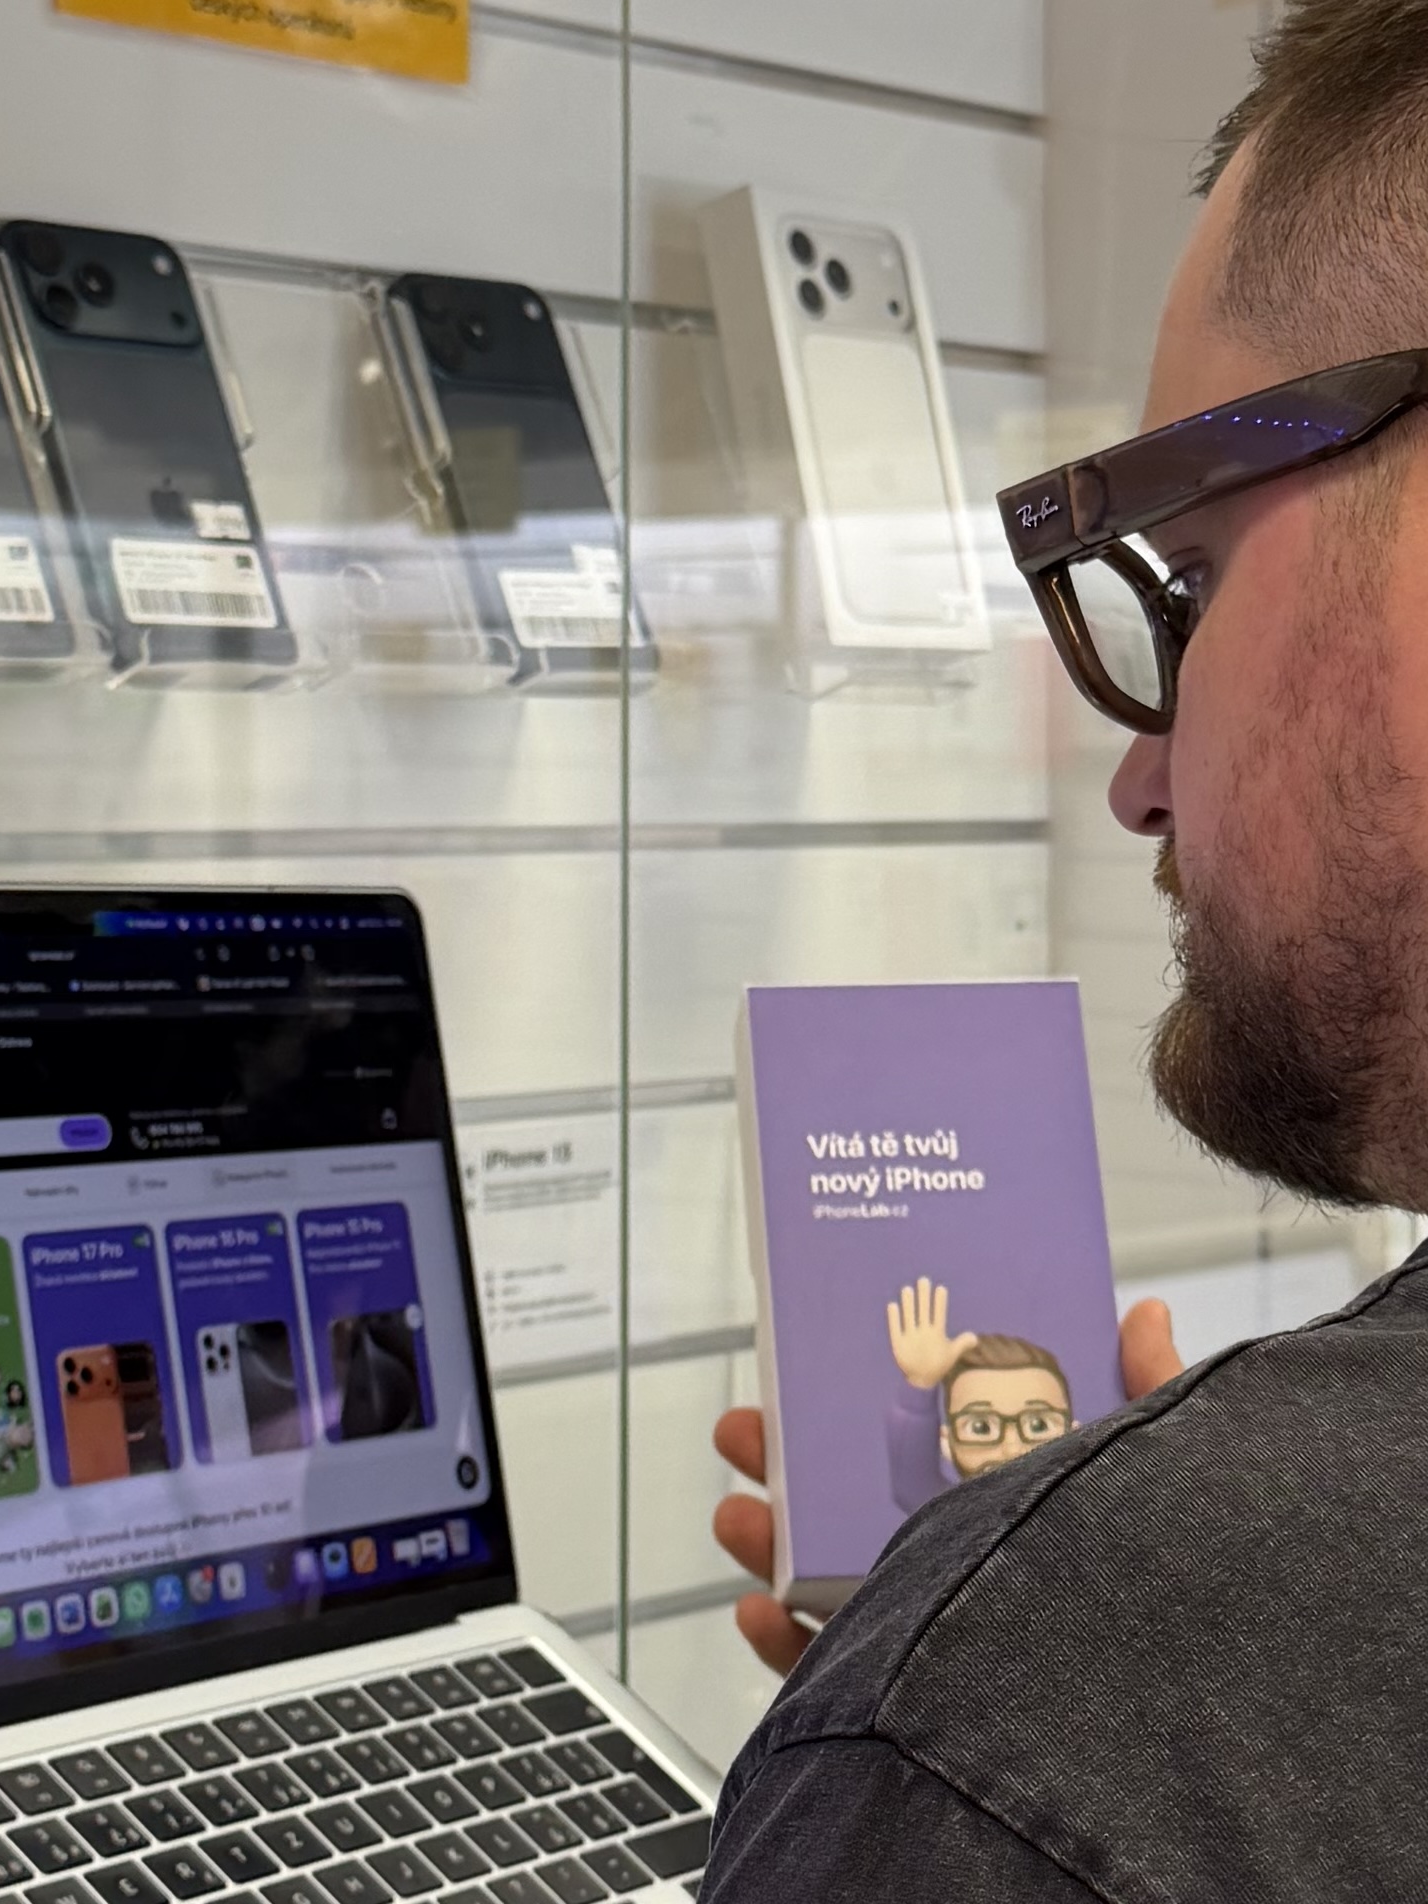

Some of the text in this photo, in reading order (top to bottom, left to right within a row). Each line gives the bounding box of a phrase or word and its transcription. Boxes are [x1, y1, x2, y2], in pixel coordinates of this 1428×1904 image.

[806, 1128, 960, 1162] Vítá tě tvůj
[810, 1165, 986, 1199] nový iPhone
[118, 1876, 139, 1898] E
[174, 1861, 196, 1881] R
[228, 1845, 248, 1865] T
[282, 1831, 304, 1851] Z
[334, 1816, 355, 1836] U
[343, 1876, 364, 1895] H
